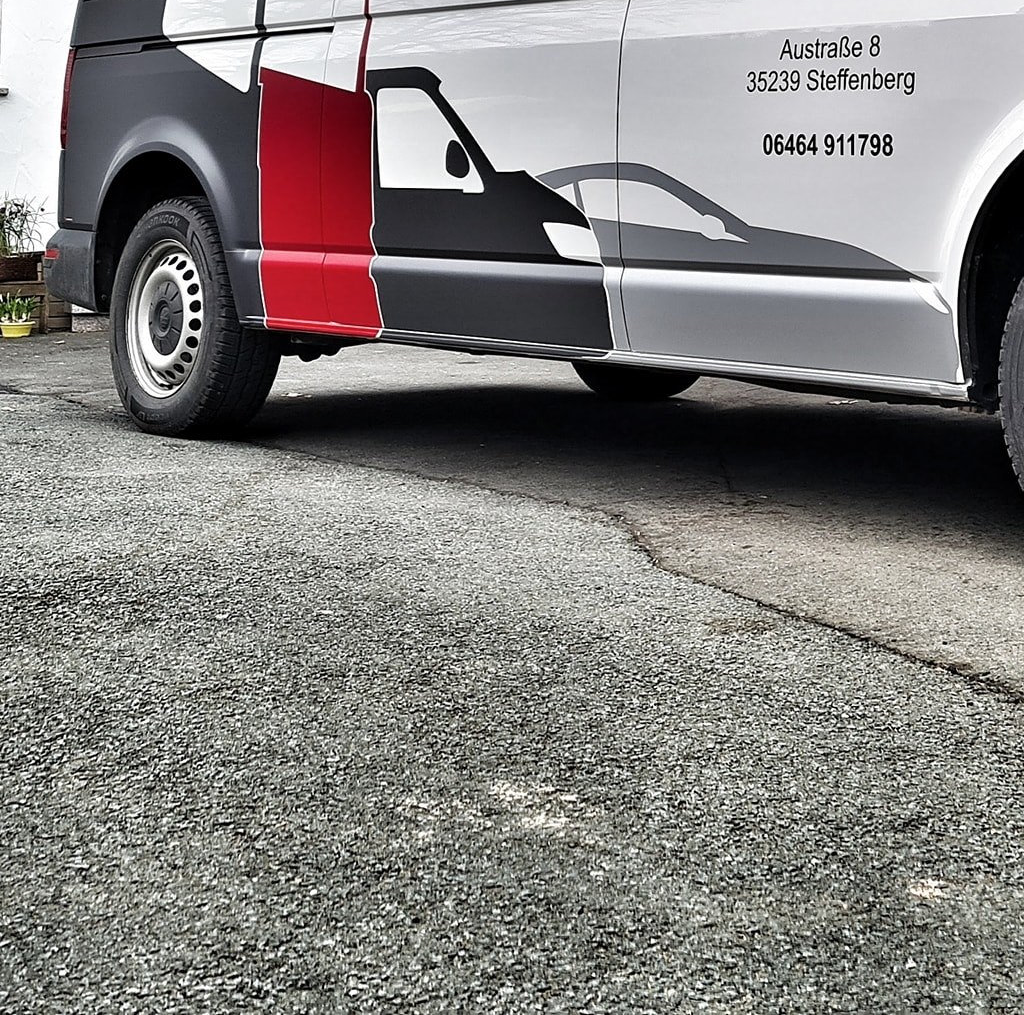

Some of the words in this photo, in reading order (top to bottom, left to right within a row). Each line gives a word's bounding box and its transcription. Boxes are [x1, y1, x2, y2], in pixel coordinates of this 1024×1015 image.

[780, 36, 863, 60] Austraße
[869, 35, 881, 57] 8
[747, 70, 800, 93] 35239
[807, 68, 915, 95] Steffenberg
[763, 134, 818, 156] 06464
[824, 133, 893, 156] 911798
